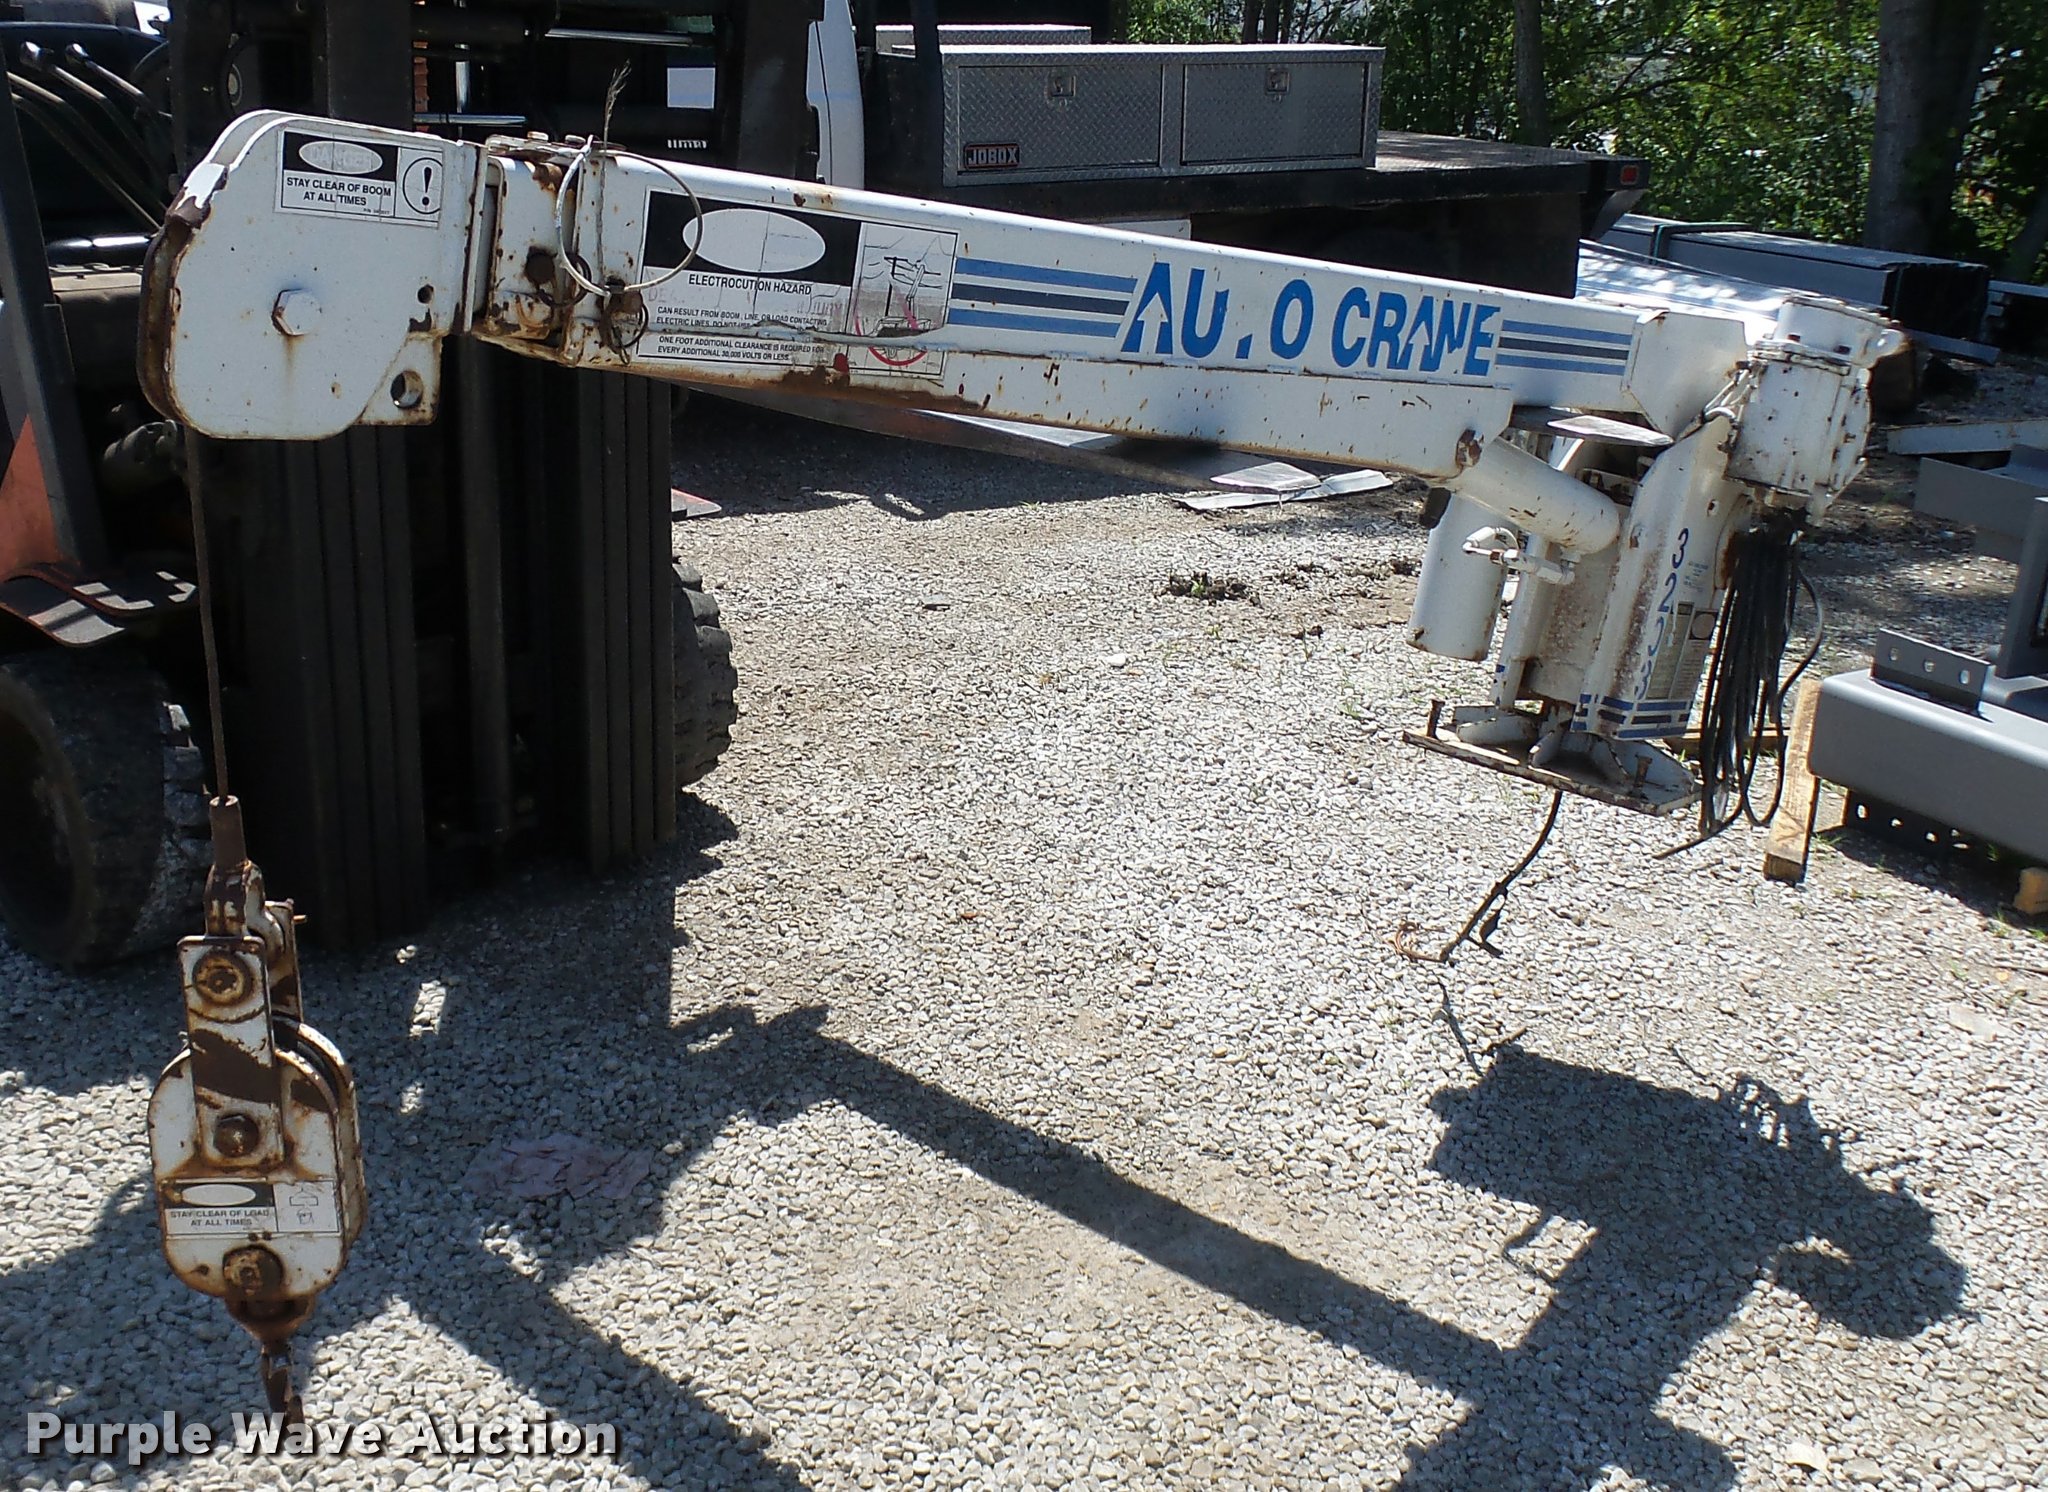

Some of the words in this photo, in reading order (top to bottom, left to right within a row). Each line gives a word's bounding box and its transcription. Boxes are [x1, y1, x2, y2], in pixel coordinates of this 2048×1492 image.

[968, 148, 1018, 164] JOBOX
[287, 177, 310, 188] STAY
[312, 179, 345, 192] CLEAR
[347, 183, 360, 193] OF
[362, 185, 391, 197] BOOM
[303, 191, 316, 201] AT
[317, 193, 336, 203] ALL
[337, 194, 367, 206] TIMES
[688, 273, 772, 292] ELECTROCUTION
[773, 282, 812, 295] HAZARD
[657, 306, 673, 317] CAN
[674, 307, 699, 317] RESULT
[700, 309, 719, 319] FROM
[1120, 262, 1315, 360] AUO
[1331, 287, 1501, 376] CRANE
[656, 316, 689, 326] ELECTRIC
[659, 335, 673, 344] ONE
[675, 336, 693, 345] FOOT
[694, 338, 733, 348] ADDITIONAL
[734, 341, 771, 351] CLEARANCE
[773, 343, 779, 351] IS
[780, 343, 810, 353] REQUIRED
[811, 345, 824, 353] FOR
[657, 345, 681, 355] EVERY
[681, 347, 721, 357] ADDITIONAL
[741, 351, 761, 360] VOLTS
[170, 1210, 194, 1219] STAY
[195, 1210, 227, 1218] CLEAR
[229, 1209, 242, 1218] OF
[244, 1209, 270, 1217] LOAD
[190, 1219, 202, 1227] AT
[204, 1218, 222, 1226] ALL
[225, 1218, 253, 1226] TIMES
